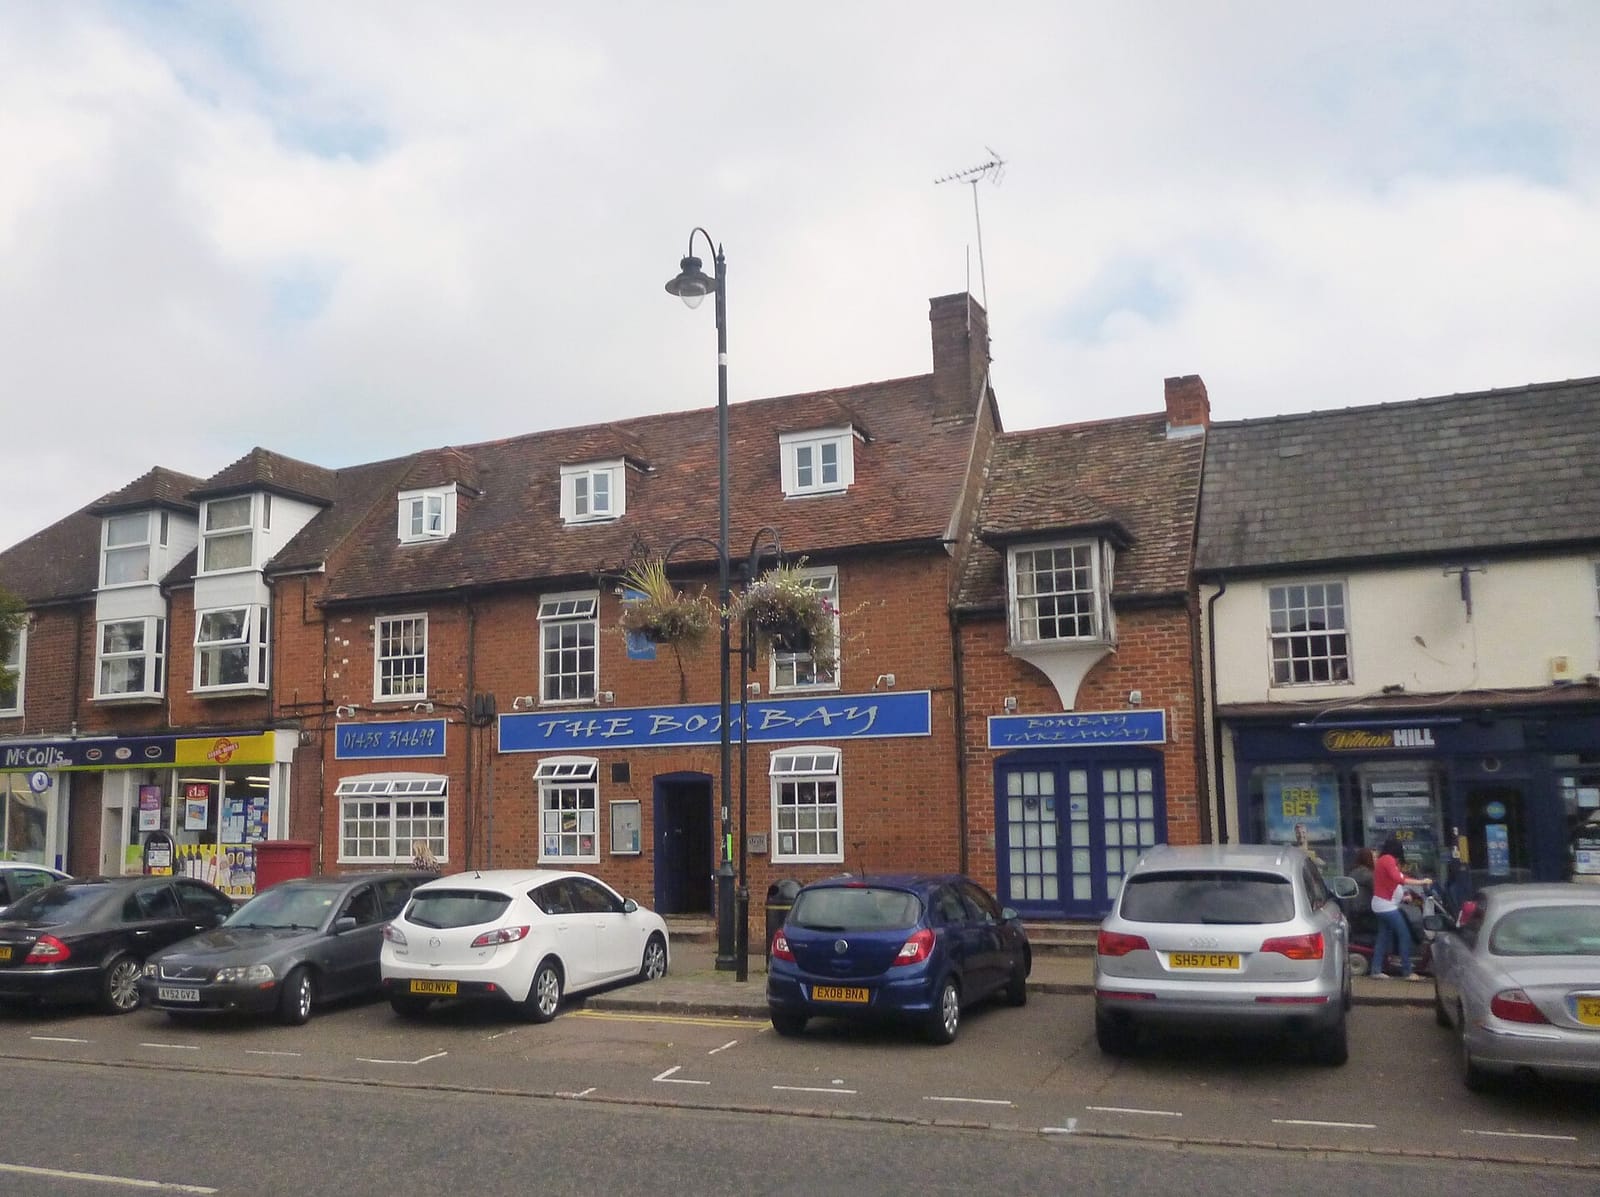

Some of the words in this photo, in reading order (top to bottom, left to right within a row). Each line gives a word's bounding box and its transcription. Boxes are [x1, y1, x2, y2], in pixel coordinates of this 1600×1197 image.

[538, 717, 634, 738] THE
[1027, 715, 1127, 729] BOMBAY
[1394, 728, 1435, 746] HILL
[6, 747, 64, 766] McColl's
[1282, 787, 1318, 800] FREE
[1283, 800, 1318, 816] BET
[1175, 954, 1206, 966] SH57
[1210, 954, 1233, 967] CFY
[436, 981, 451, 991] NVK
[818, 987, 842, 998] EX08
[846, 988, 864, 999] BNA
